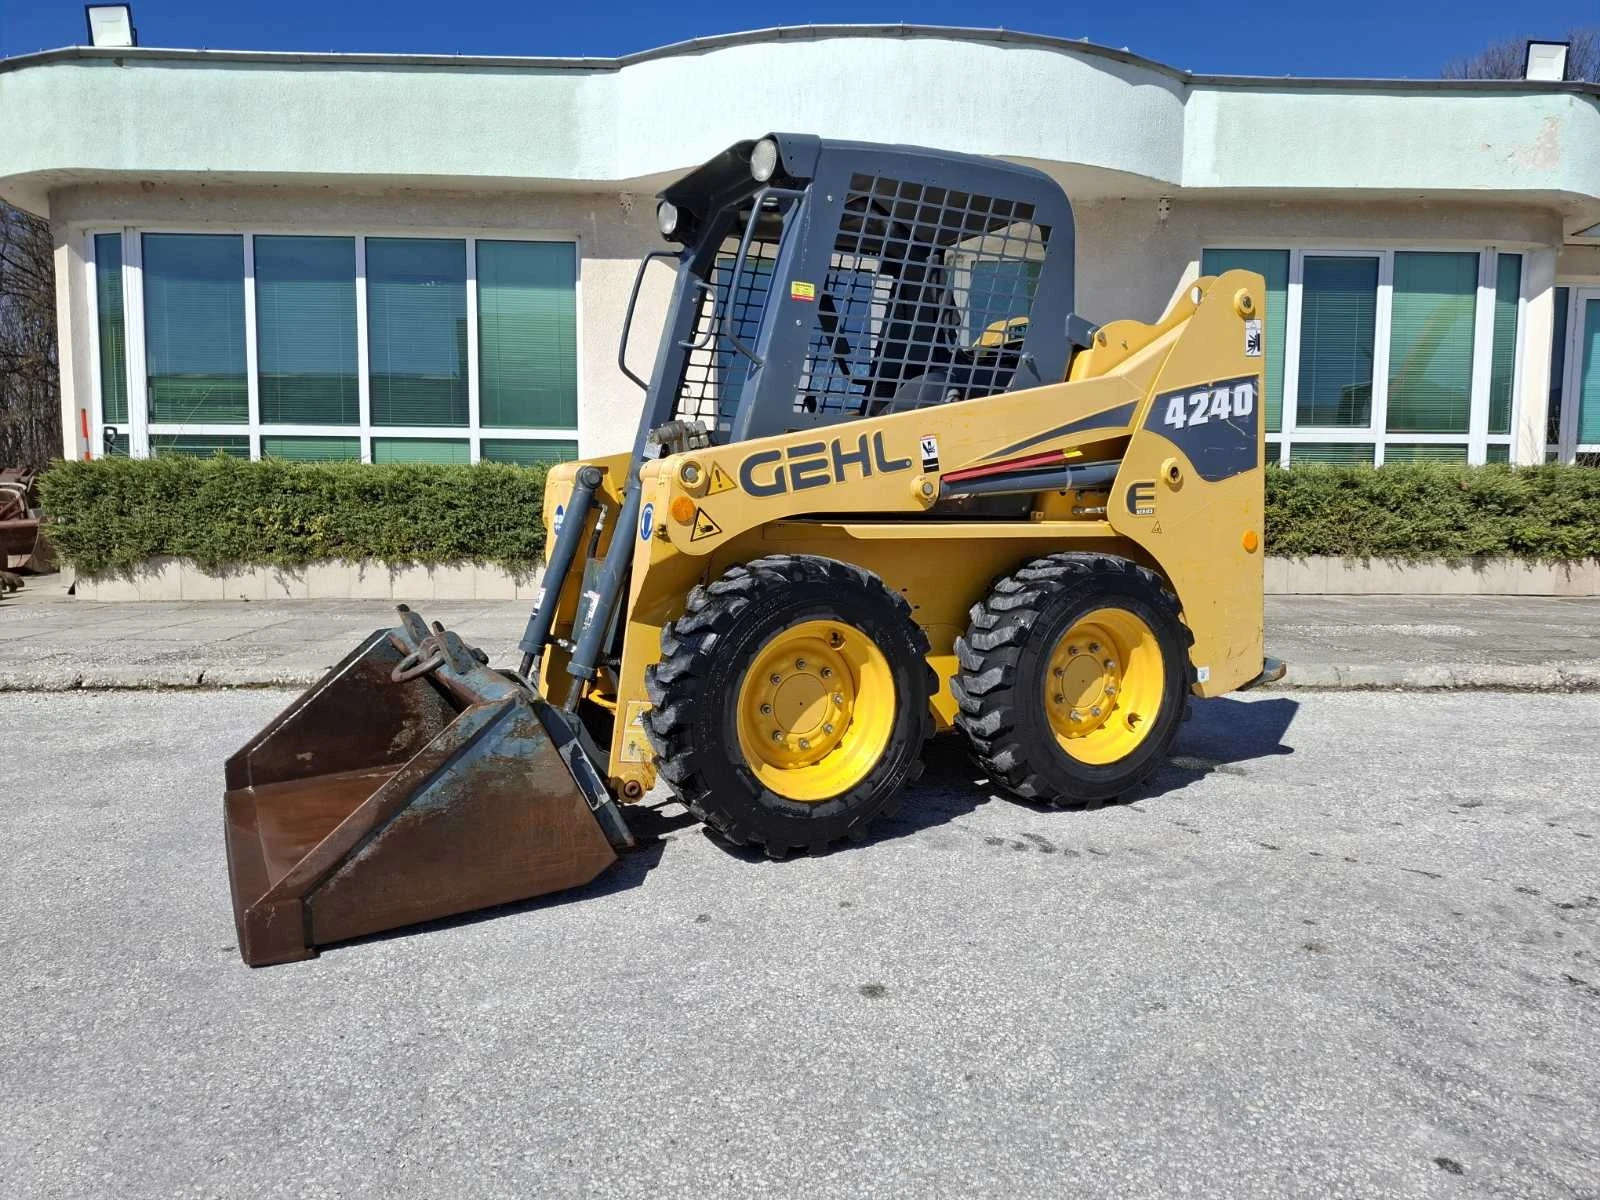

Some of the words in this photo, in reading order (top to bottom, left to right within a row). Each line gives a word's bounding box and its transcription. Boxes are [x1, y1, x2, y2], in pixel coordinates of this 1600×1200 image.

[1164, 383, 1253, 430] 4240
[739, 431, 911, 497] GEHL
[1126, 482, 1155, 515] E
